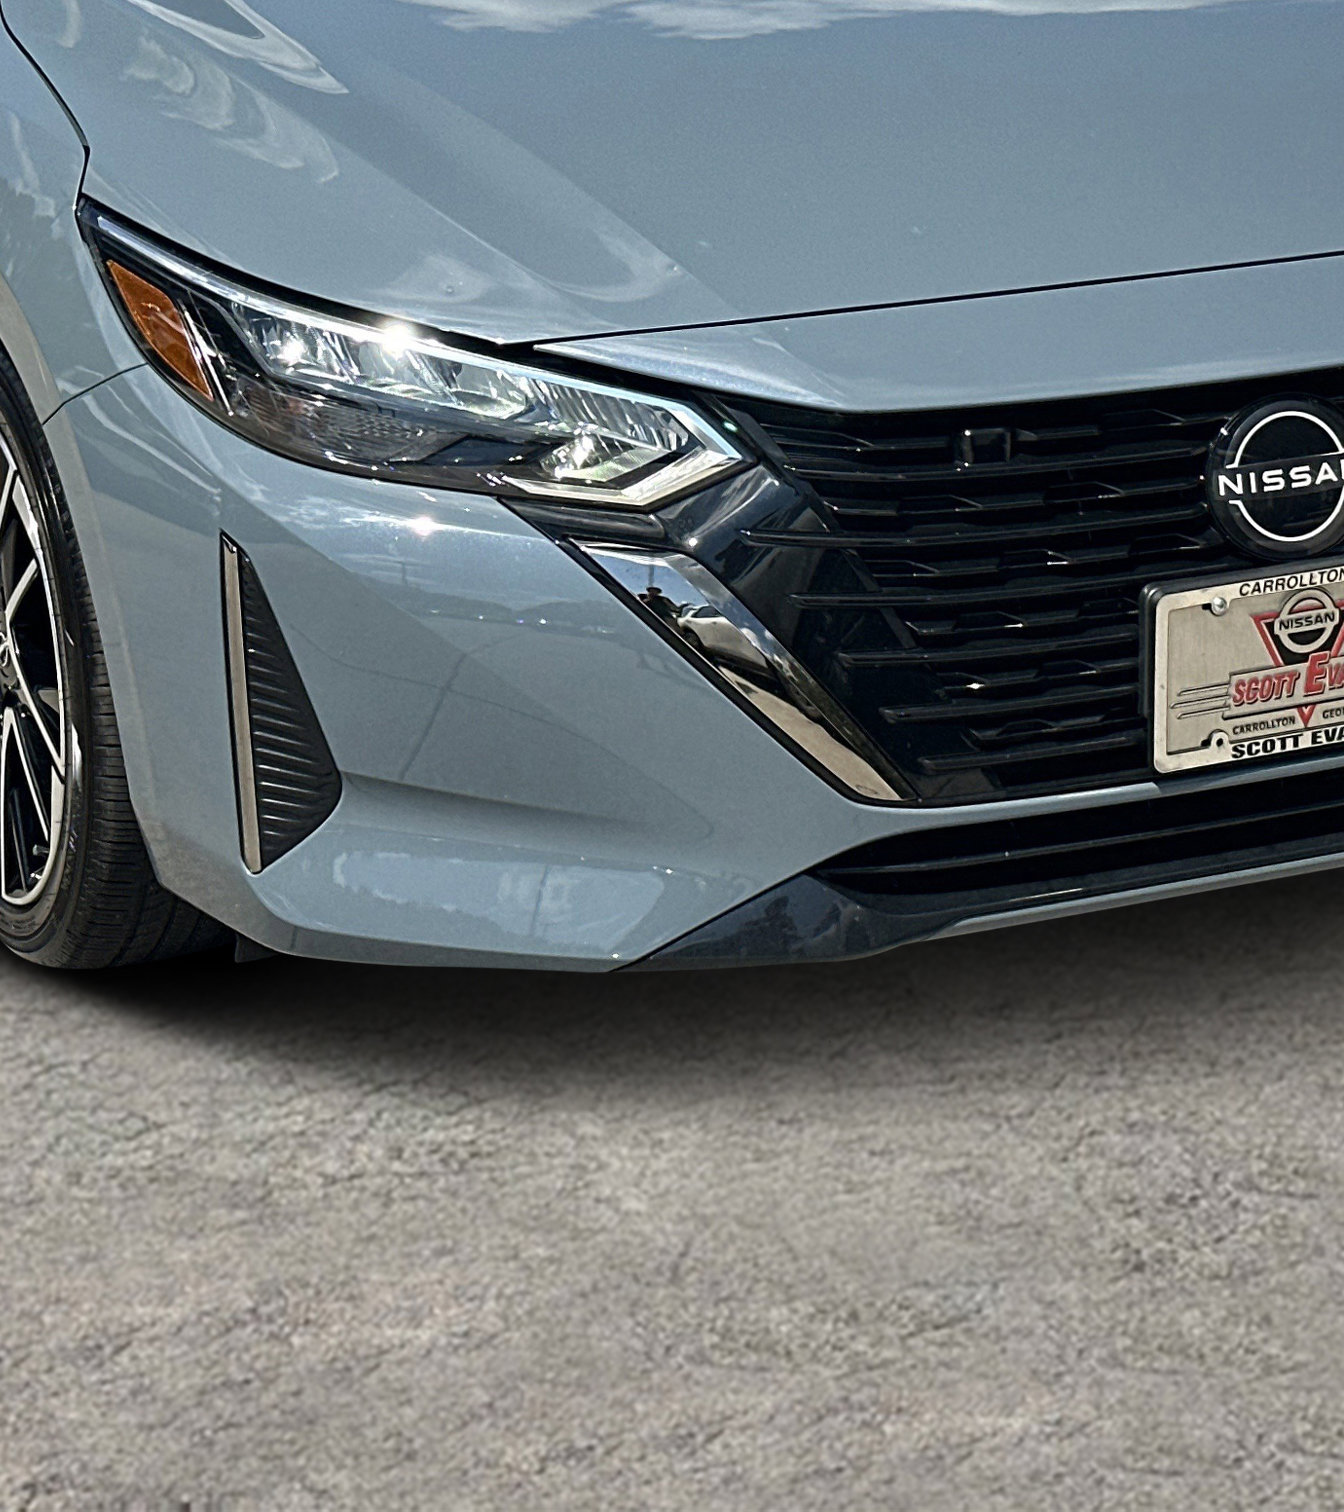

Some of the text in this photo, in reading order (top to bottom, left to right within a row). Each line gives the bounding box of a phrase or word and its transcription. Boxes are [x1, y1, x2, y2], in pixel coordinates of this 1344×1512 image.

[1278, 610, 1336, 632] NISSAN
[1231, 669, 1301, 707] SCOTT
[1232, 715, 1296, 736] CARROLLTON
[1231, 733, 1304, 759] SCOTT
